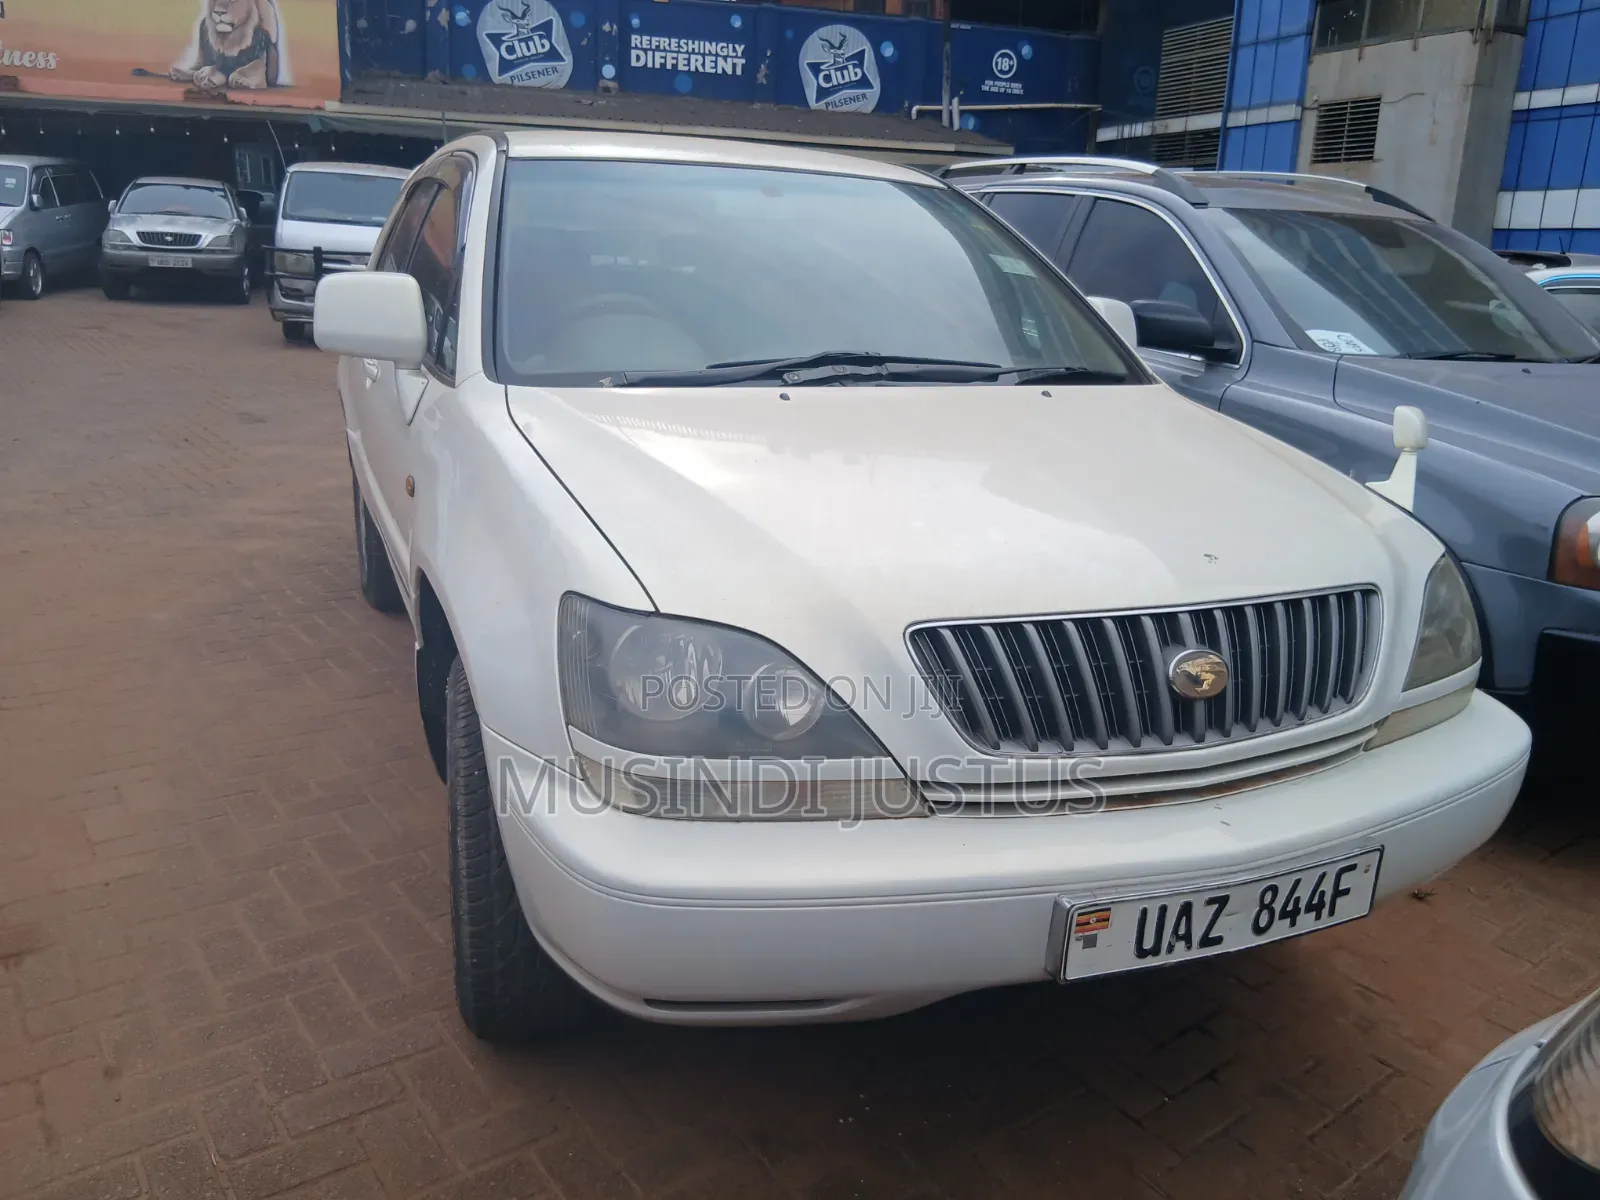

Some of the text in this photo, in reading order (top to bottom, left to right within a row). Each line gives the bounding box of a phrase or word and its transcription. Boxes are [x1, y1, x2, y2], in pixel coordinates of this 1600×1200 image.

[500, 35, 550, 60] Club
[630, 34, 746, 57] REFRESHINGLY
[630, 48, 746, 76] DIFFERENT
[996, 57, 1014, 71] 18+
[509, 66, 559, 85] PILSENER
[818, 64, 863, 88] Club
[824, 93, 869, 111] PILSENER
[1134, 863, 1358, 960] UAZ 844F
